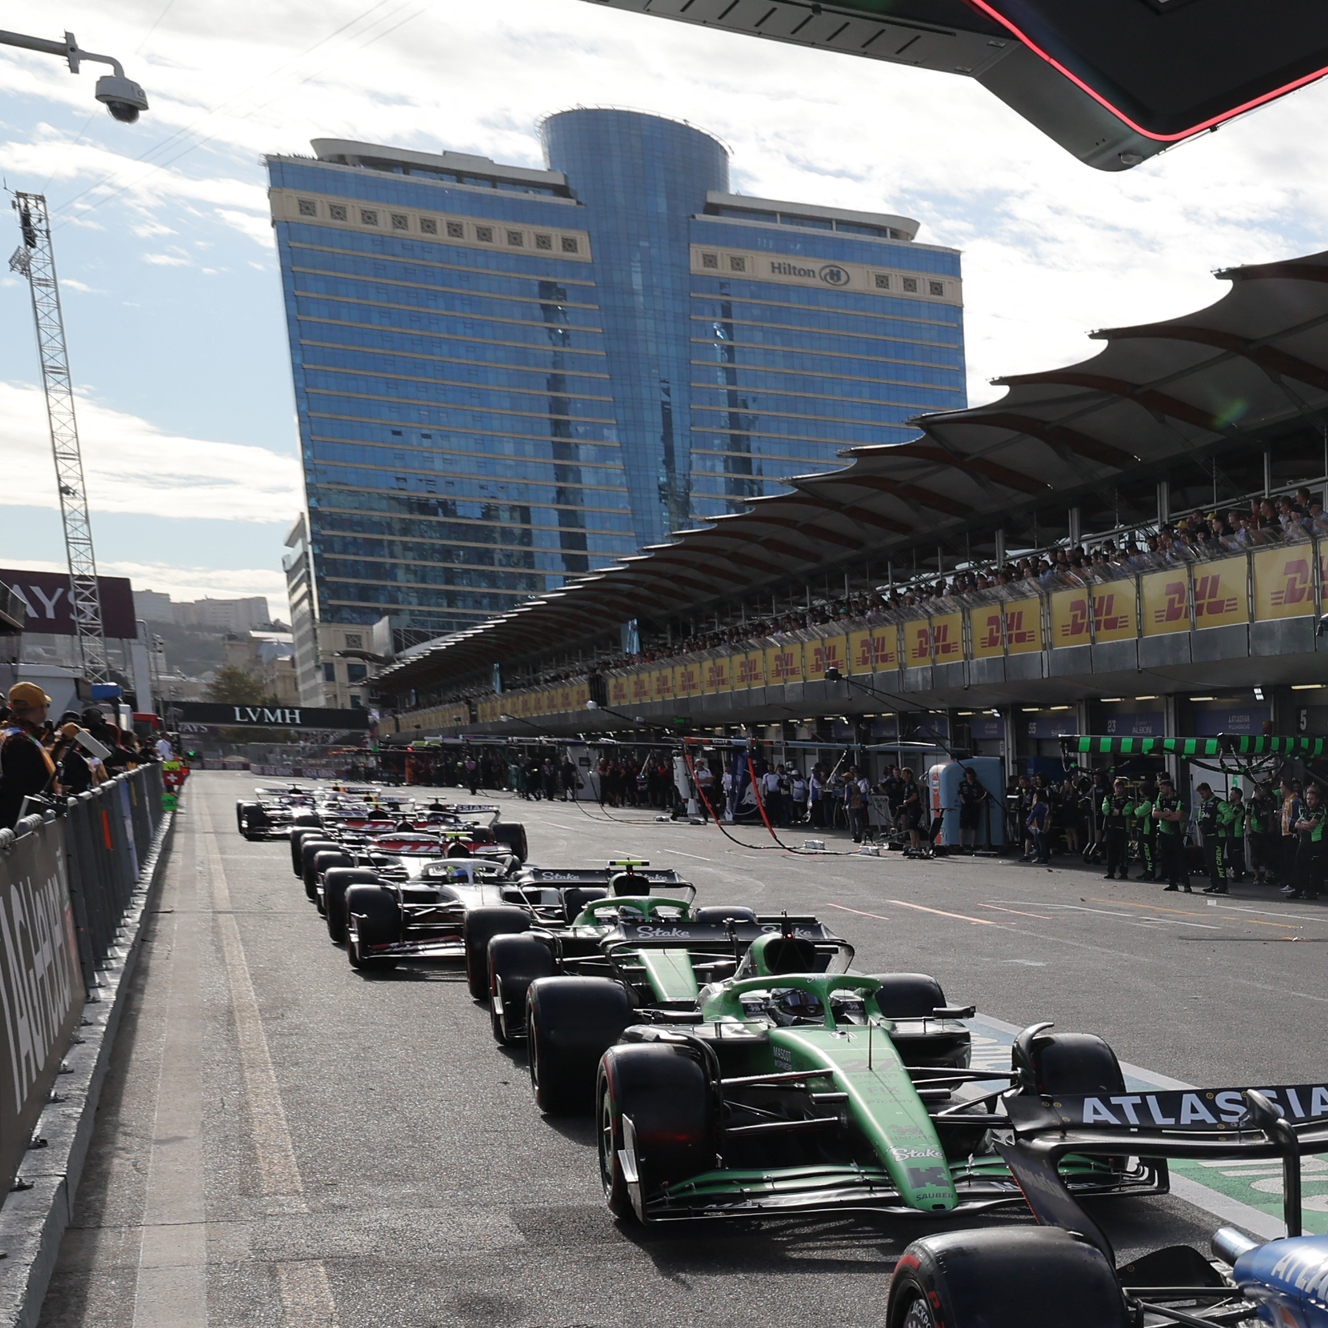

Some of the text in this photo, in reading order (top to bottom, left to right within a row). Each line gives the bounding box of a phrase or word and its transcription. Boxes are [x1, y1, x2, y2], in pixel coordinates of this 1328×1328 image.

[770, 262, 816, 278] Hilton
[1164, 574, 1225, 623] DHL
[1069, 594, 1120, 636] DHL
[987, 611, 1028, 648] DHL
[916, 624, 950, 658] DHL
[860, 636, 886, 666] DHL
[234, 707, 301, 724] LVMH
[1300, 710, 1308, 730] 5
[1107, 720, 1152, 734] 23 ALBON
[1143, 842, 1152, 861] CREW
[1215, 846, 1226, 878] PIT CREW
[541, 871, 580, 881] Stake
[636, 925, 691, 939] Stake
[773, 1046, 791, 1062] MASCOT
[842, 1057, 897, 1073] 27
[892, 1147, 944, 1162] Stake
[916, 1193, 954, 1201] SAUBER
